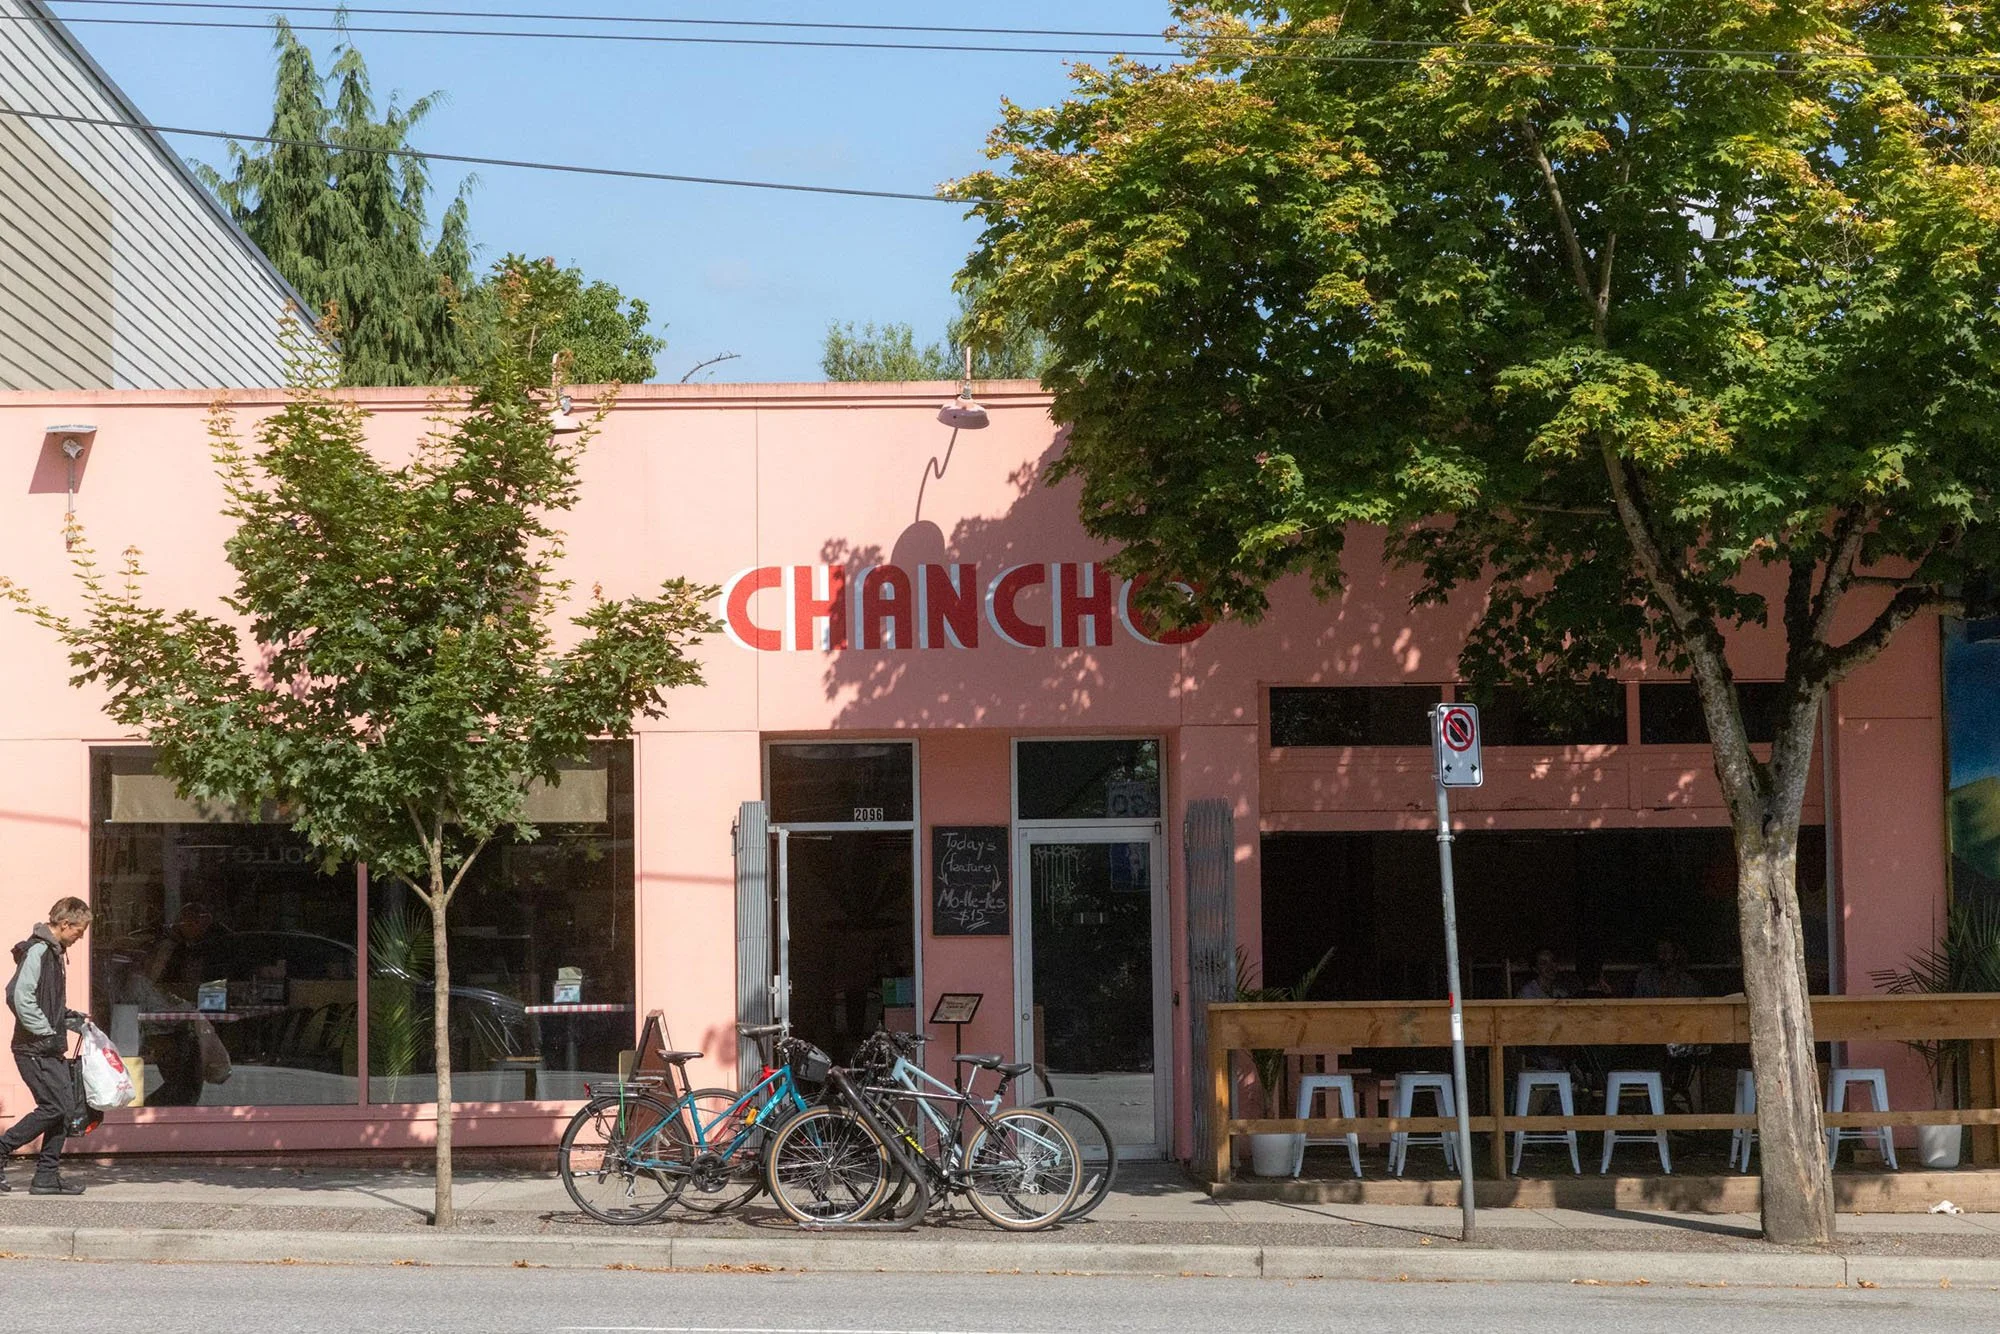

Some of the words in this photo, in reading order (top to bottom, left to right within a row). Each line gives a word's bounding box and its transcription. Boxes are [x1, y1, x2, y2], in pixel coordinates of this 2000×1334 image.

[720, 562, 1215, 651] CHANCHO
[855, 808, 882, 821] 2096
[942, 832, 997, 861] Today's
[953, 908, 986, 927] $15
